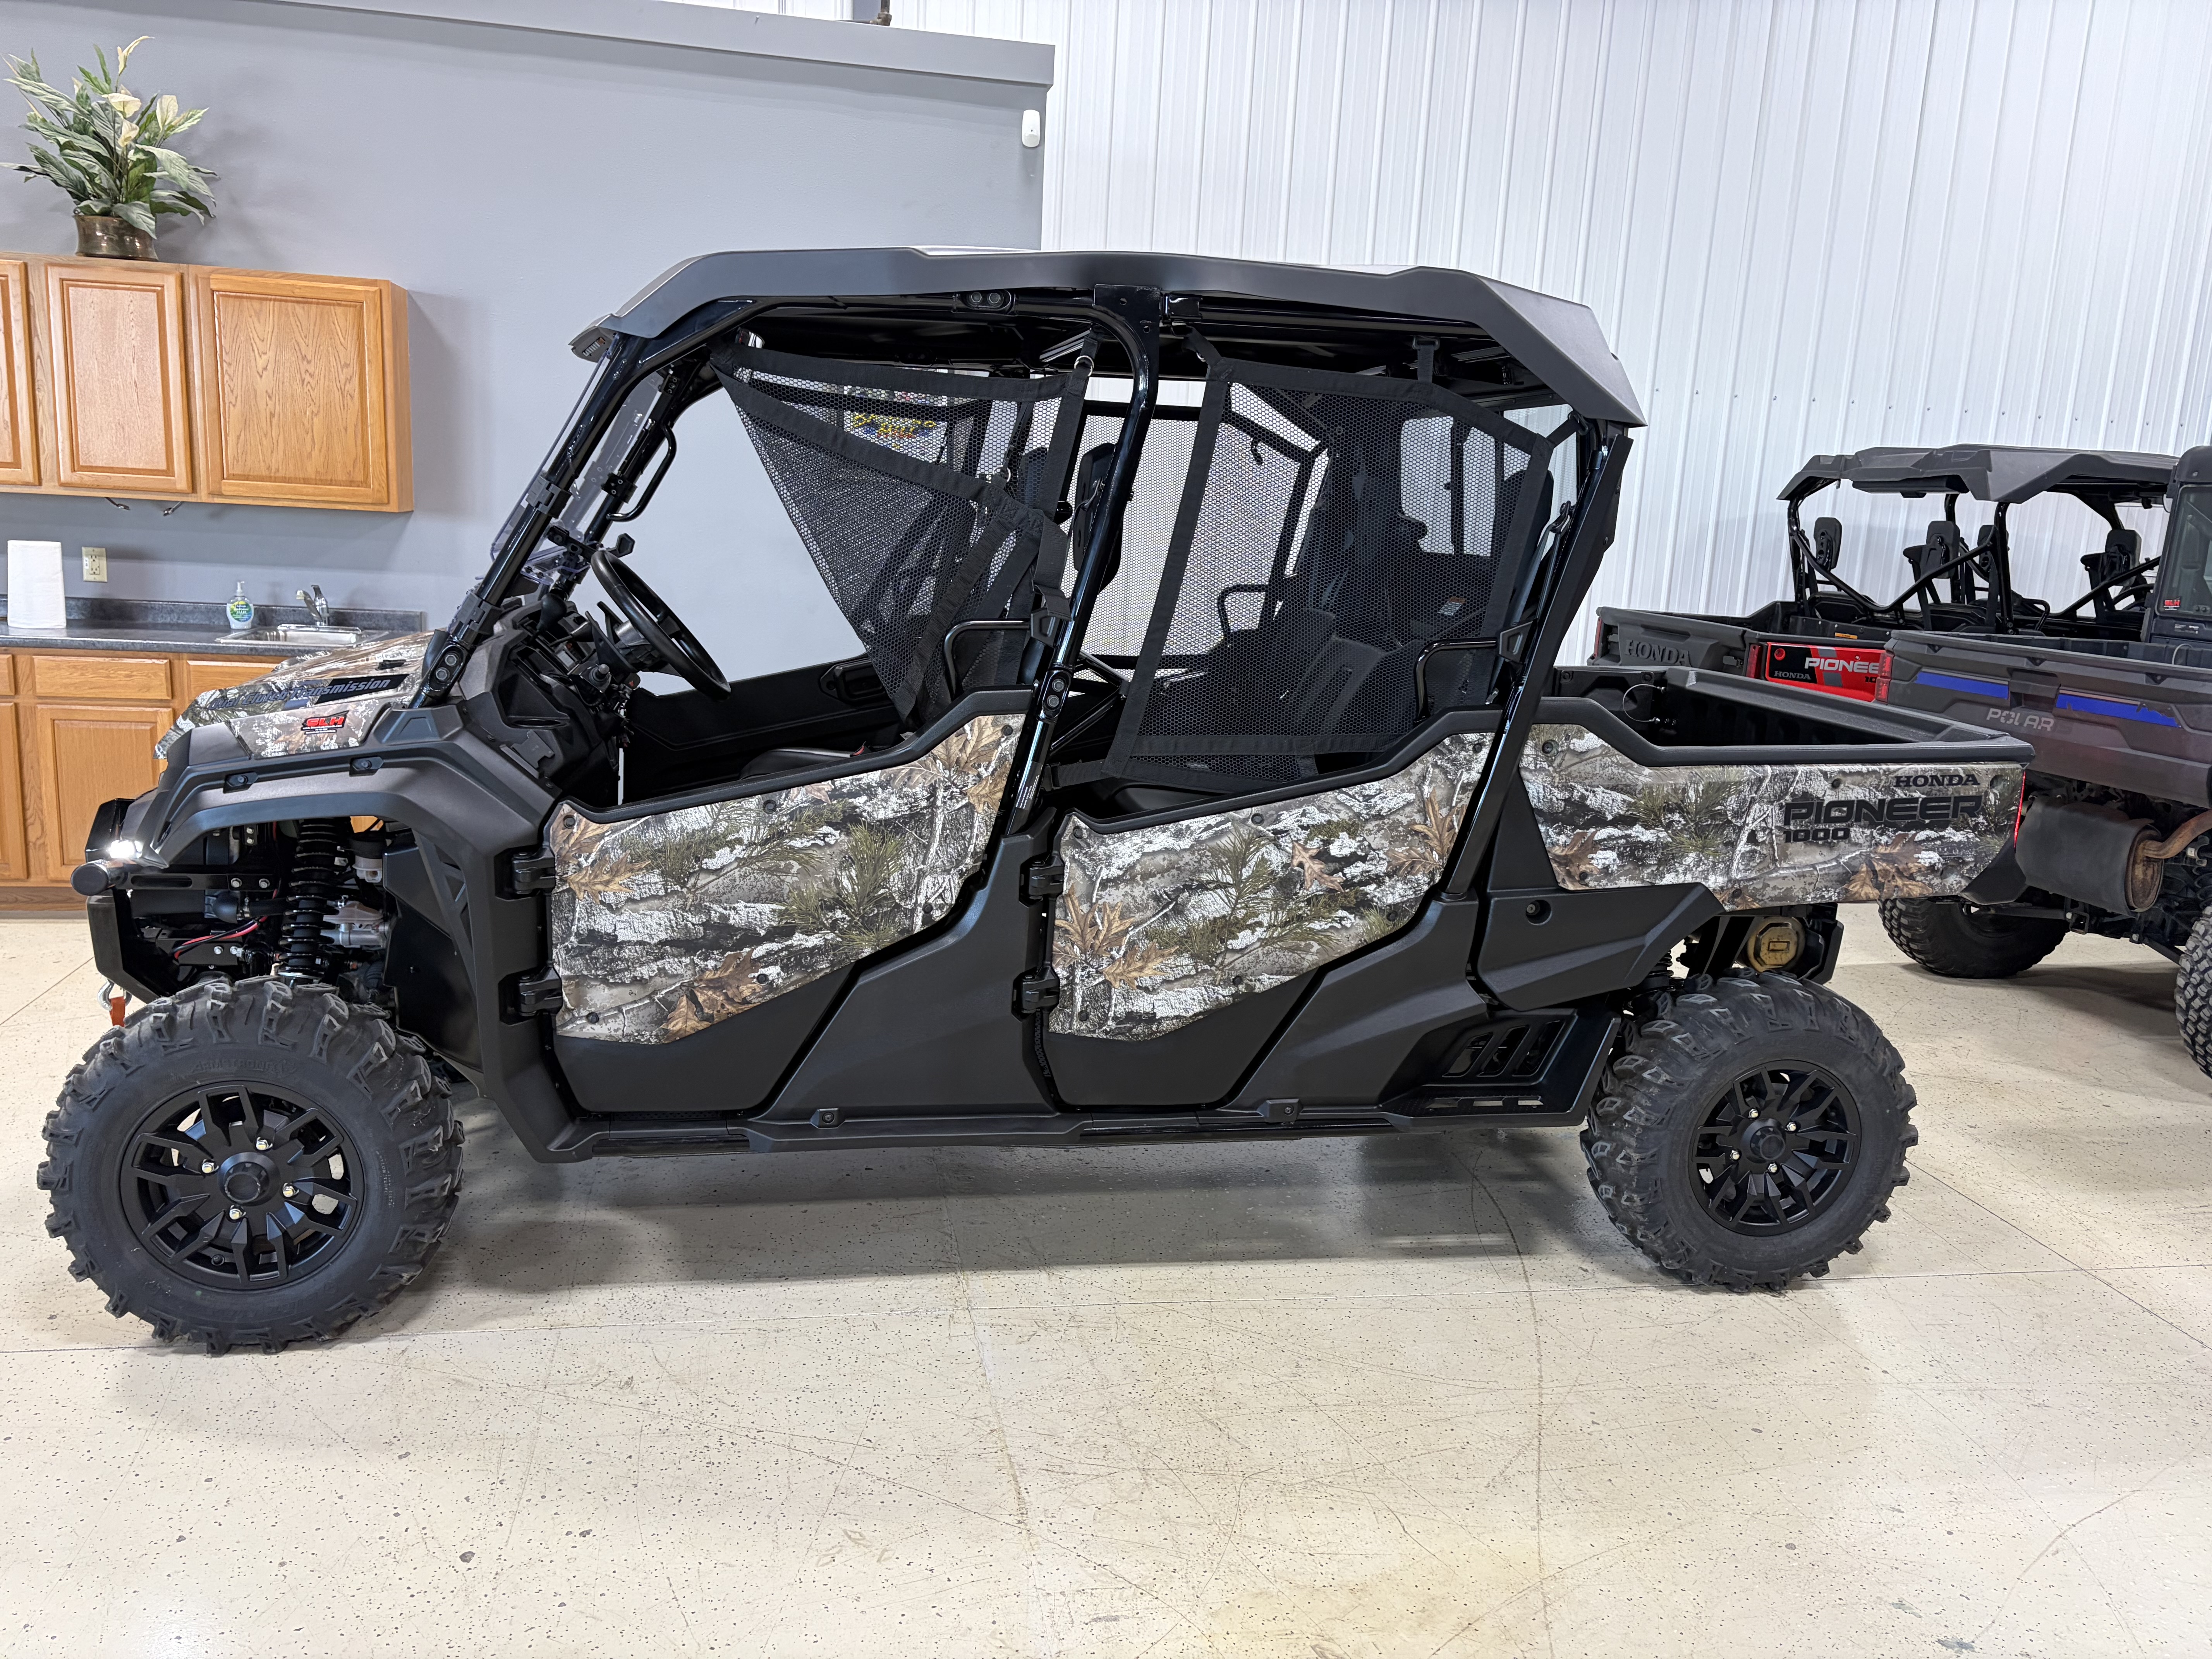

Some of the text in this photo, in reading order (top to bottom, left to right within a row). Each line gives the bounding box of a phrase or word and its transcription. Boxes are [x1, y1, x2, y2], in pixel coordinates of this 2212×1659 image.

[1625, 639, 1692, 667] HONDA
[1805, 657, 1880, 674] PIONEE
[1774, 671, 1811, 680] HONDA
[208, 678, 391, 710] Dual Clutch Transmission
[306, 716, 345, 726] SLH
[1894, 775, 1980, 787] HONDA
[1784, 795, 1983, 826] PIONEER
[1783, 828, 1850, 843] 1000
